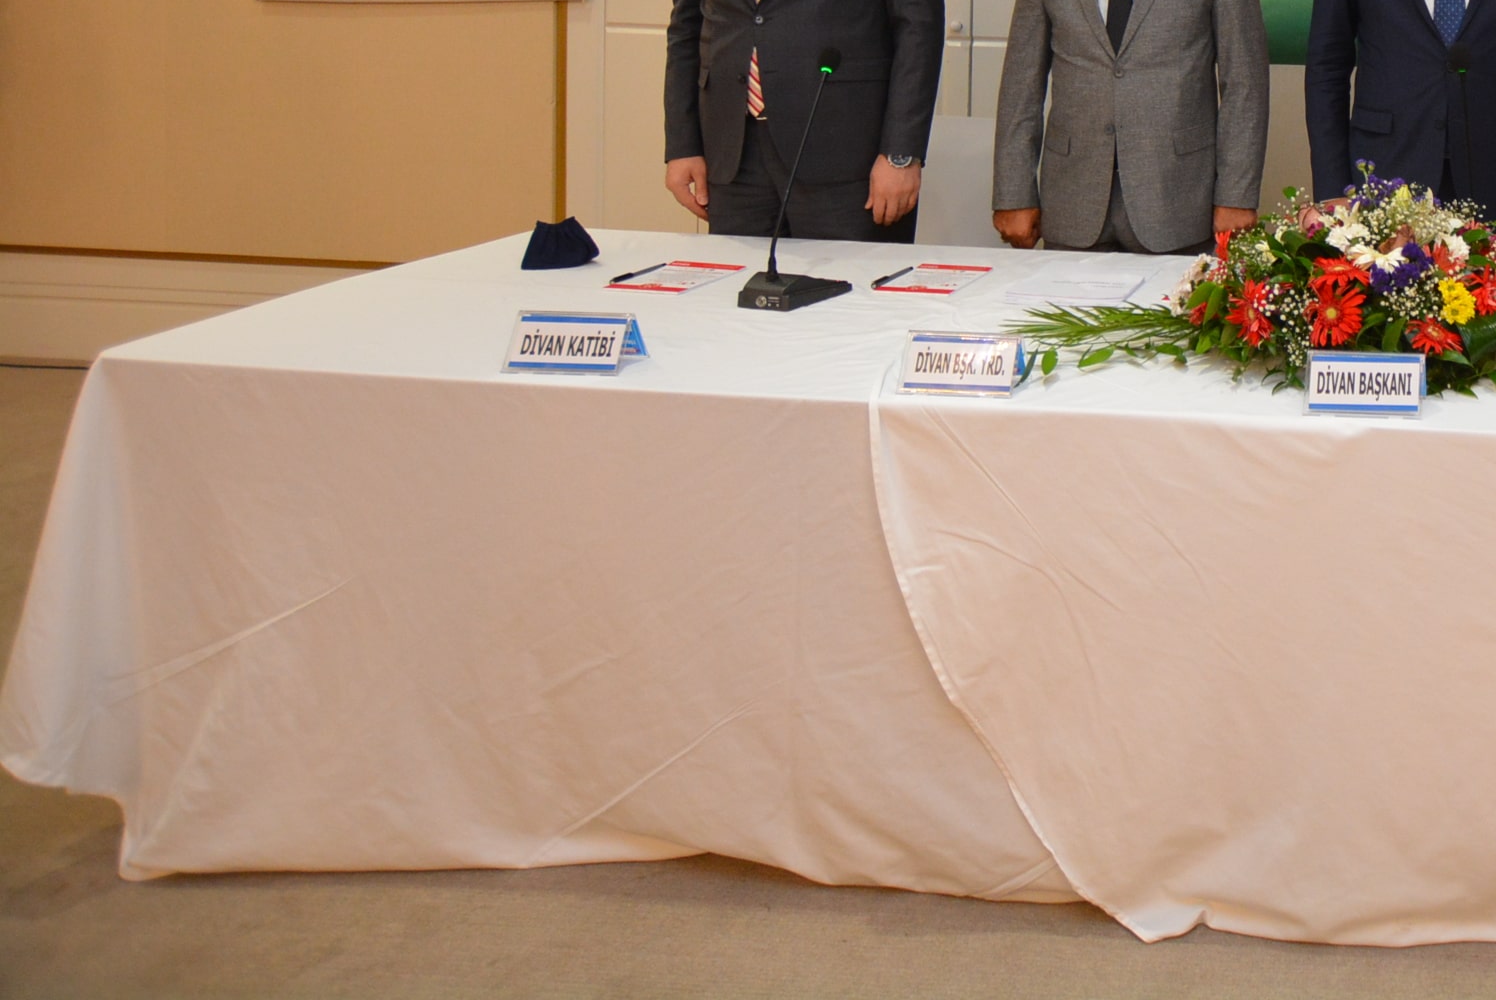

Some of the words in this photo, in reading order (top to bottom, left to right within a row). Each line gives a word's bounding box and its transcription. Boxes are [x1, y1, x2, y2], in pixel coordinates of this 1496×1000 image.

[520, 328, 566, 356] DİVAN
[566, 330, 616, 358] KATİBİ
[914, 346, 952, 374] DİVAN
[1316, 364, 1356, 396] DİVAN
[1358, 371, 1413, 402] BAŞKANI
